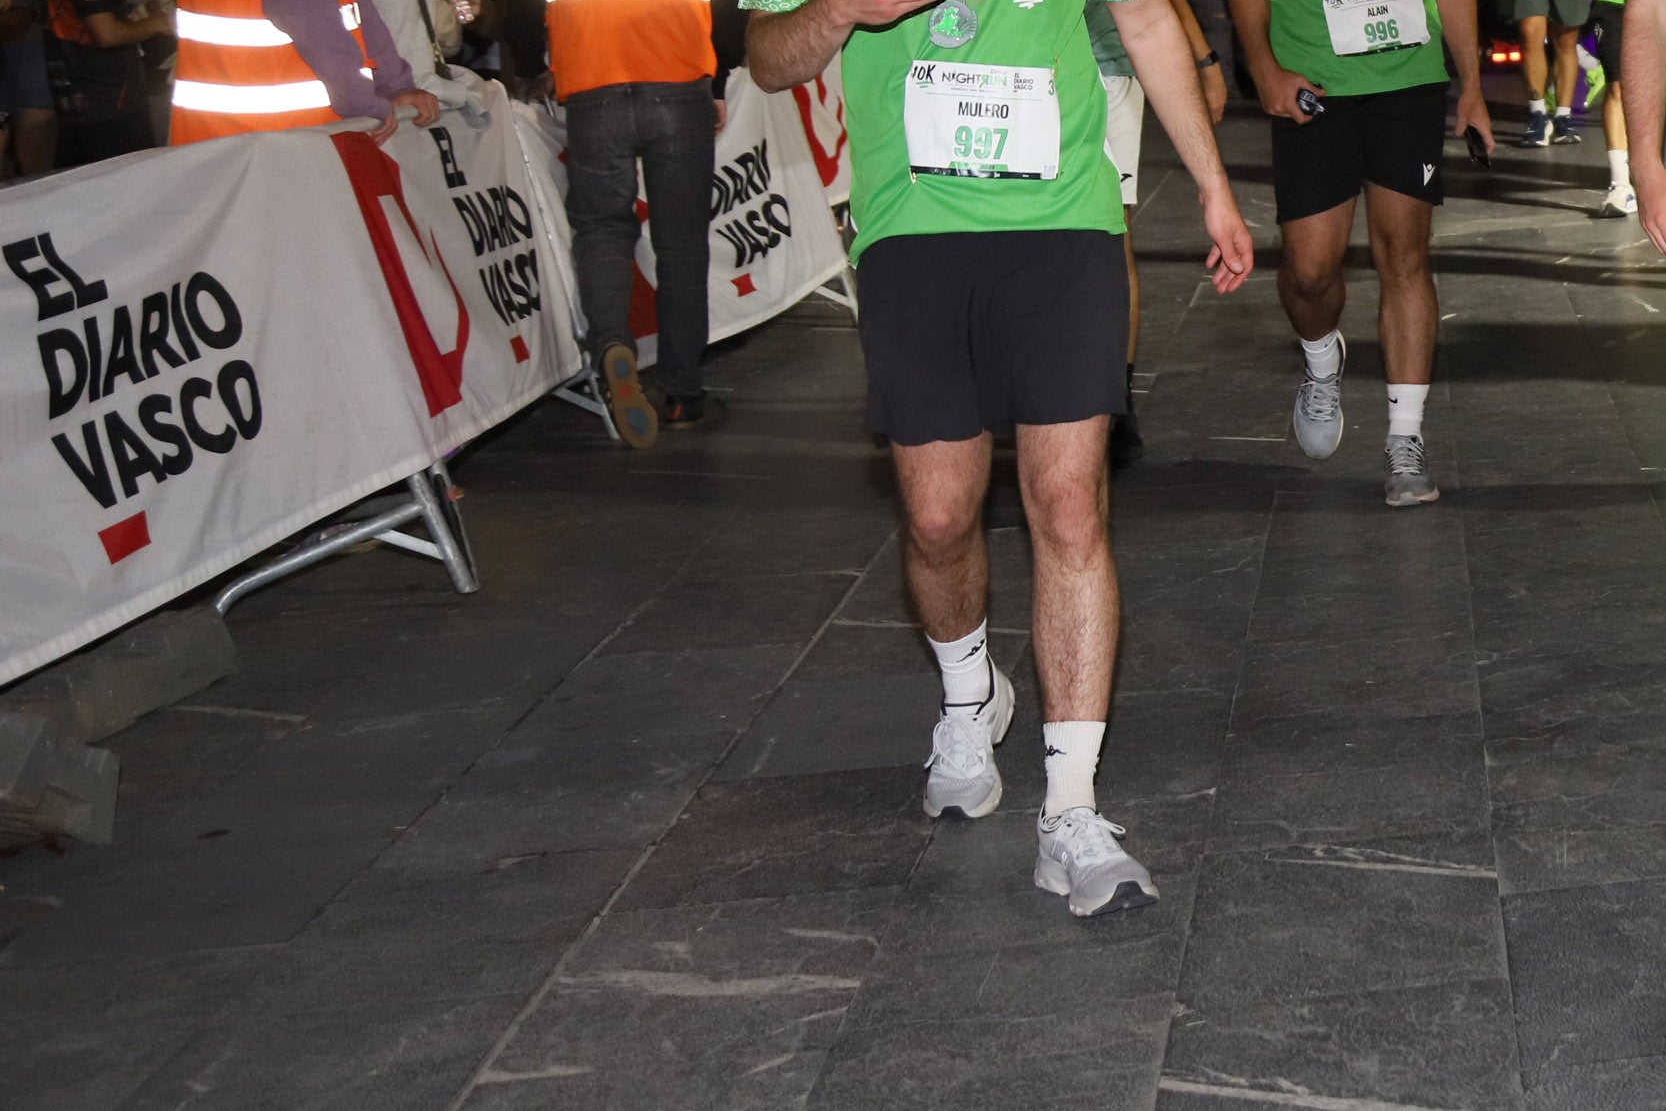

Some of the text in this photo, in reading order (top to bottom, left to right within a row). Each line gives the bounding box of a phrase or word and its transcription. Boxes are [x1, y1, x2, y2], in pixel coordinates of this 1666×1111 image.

[1367, 5, 1389, 18] ALAIN
[1364, 19, 1399, 43] 996
[912, 64, 936, 85] 10K
[1048, 79, 1055, 95] 3
[958, 101, 1009, 119] MULERO
[428, 126, 467, 188] EL
[954, 125, 1009, 160] 997
[452, 185, 533, 256] DIARIO
[2, 232, 108, 321] EL
[37, 271, 242, 420] DIARIO
[51, 359, 262, 509] VASCO
